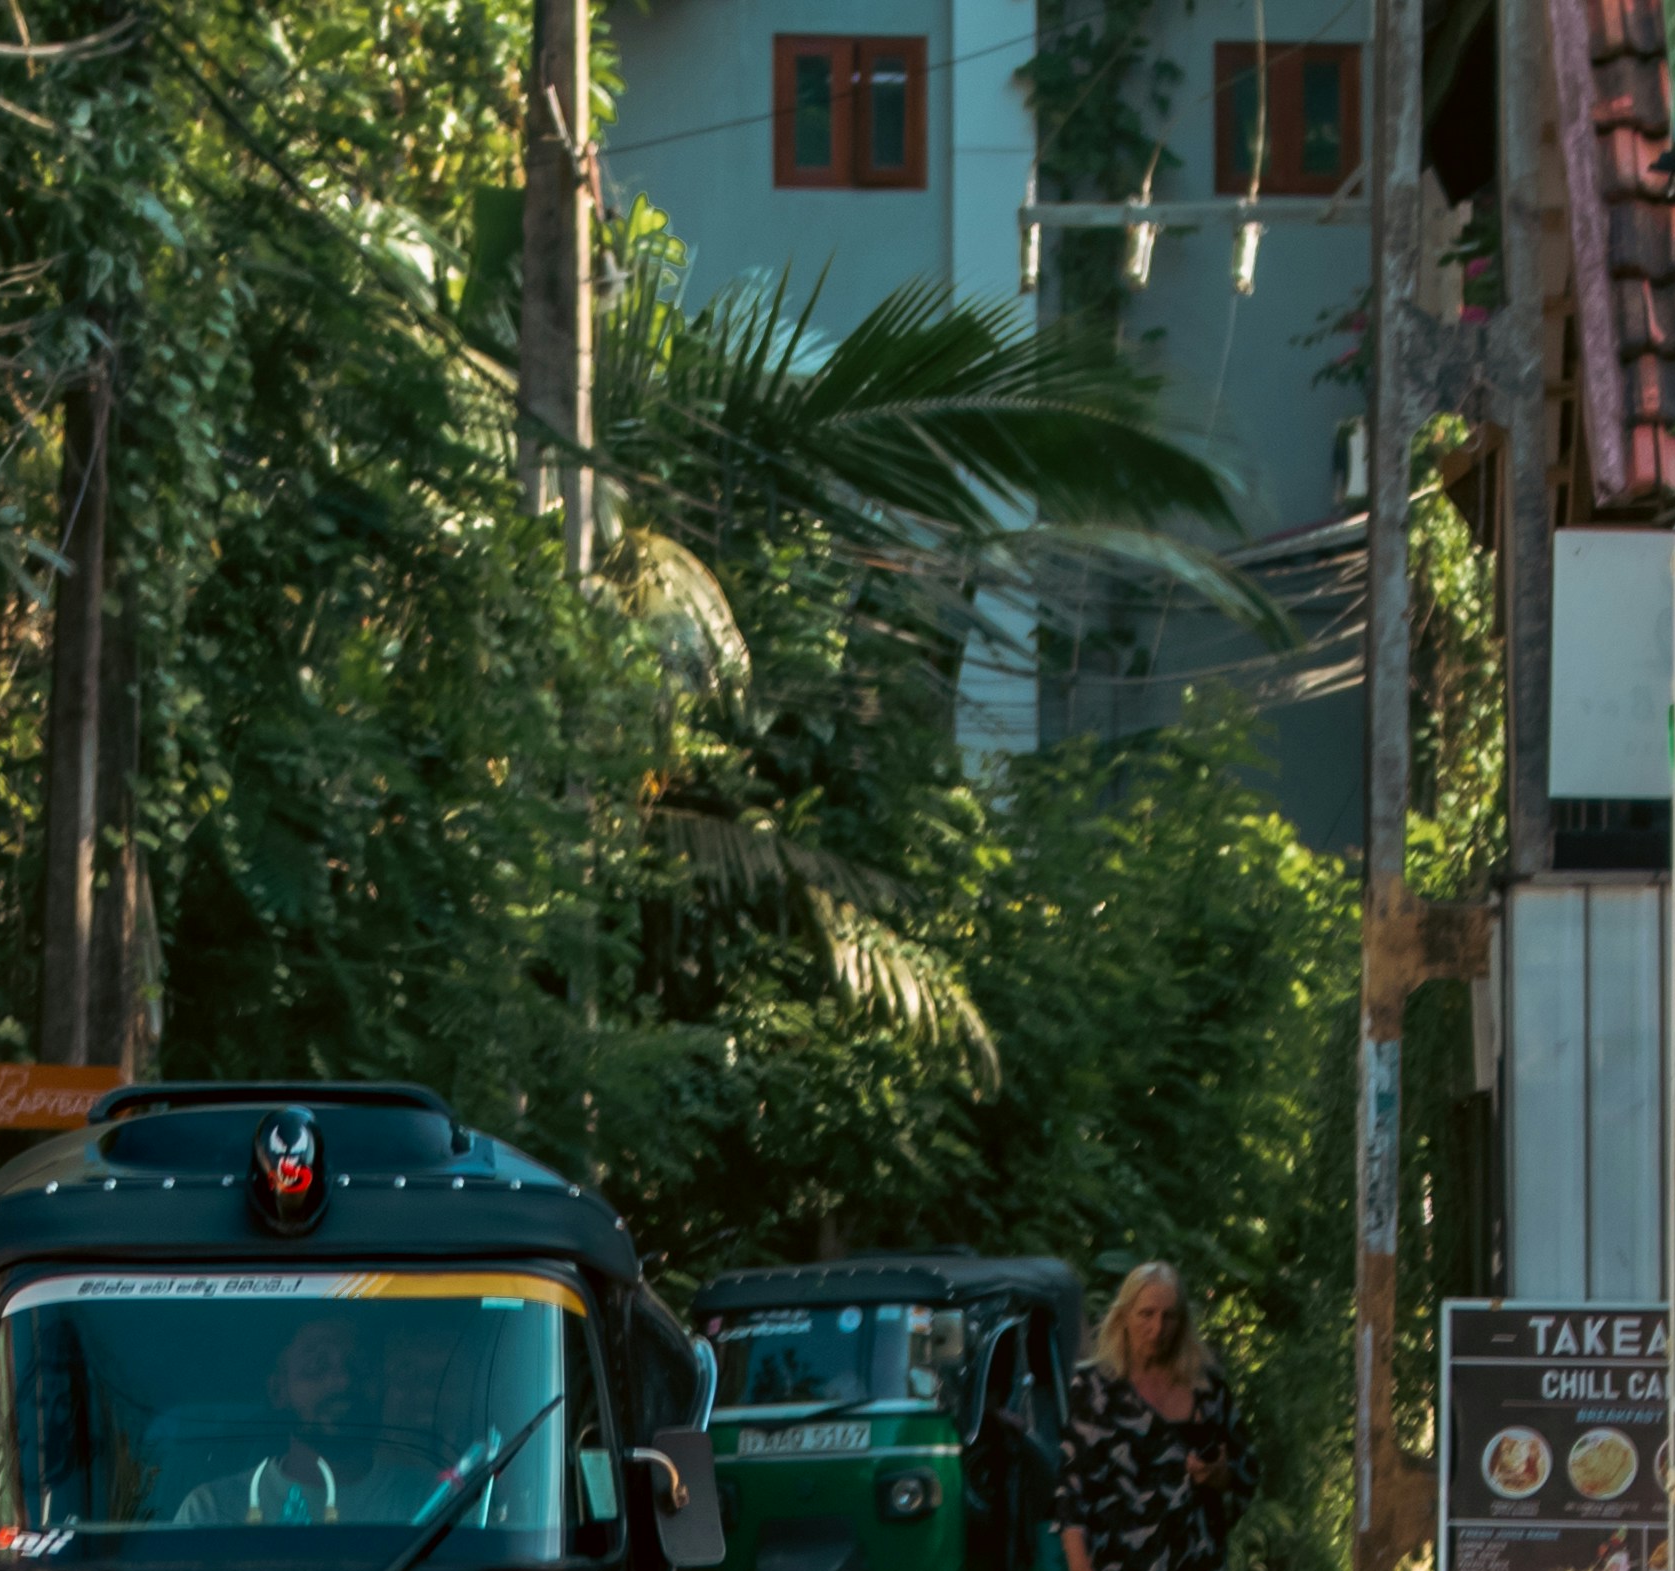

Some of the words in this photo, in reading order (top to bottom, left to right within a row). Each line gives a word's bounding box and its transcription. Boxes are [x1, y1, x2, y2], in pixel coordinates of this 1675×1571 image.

[1528, 1315, 1669, 1357] TAKEA
[1540, 1369, 1621, 1401] CHILL
[1627, 1369, 1670, 1401] CA
